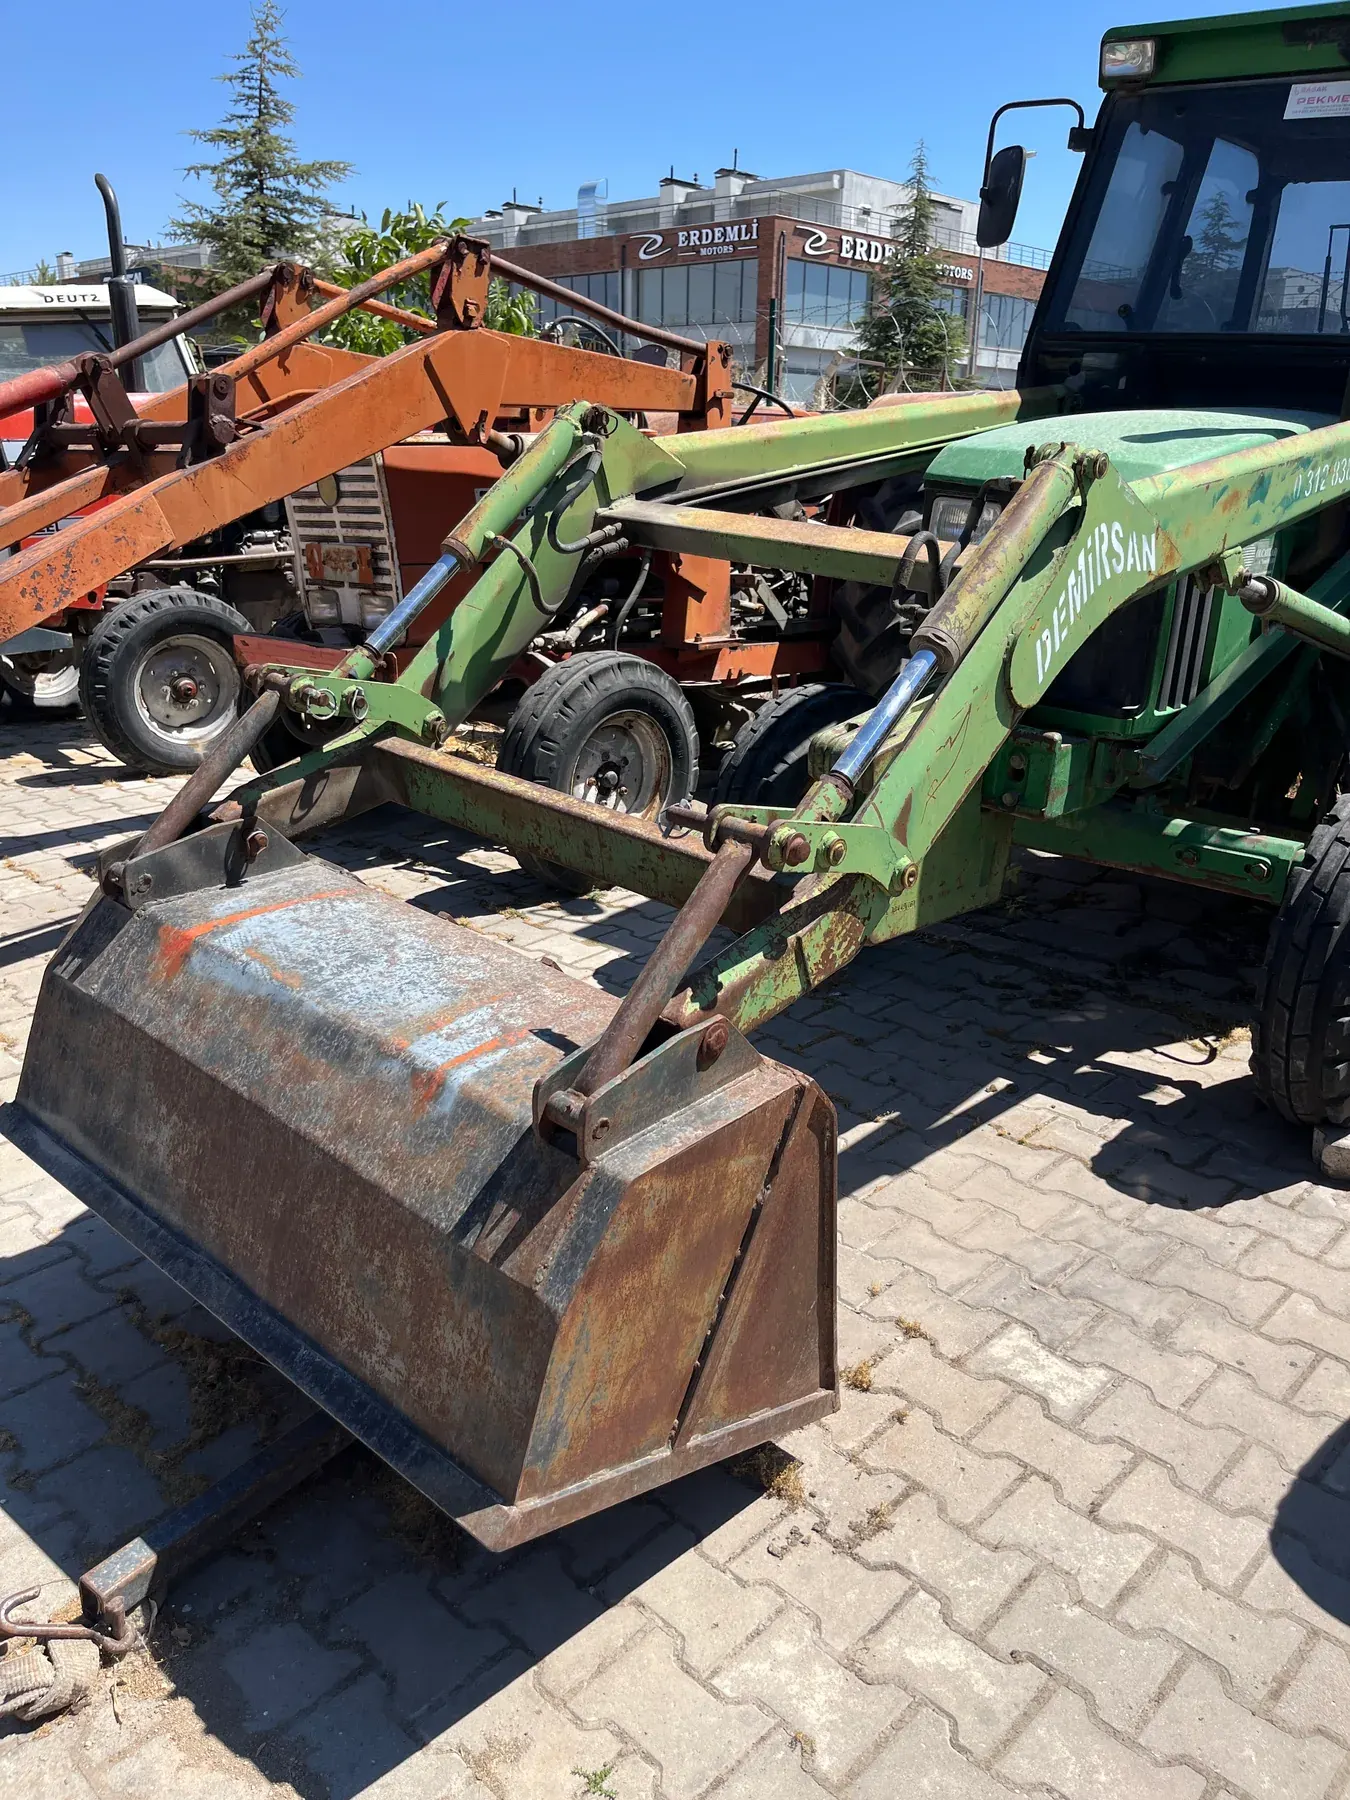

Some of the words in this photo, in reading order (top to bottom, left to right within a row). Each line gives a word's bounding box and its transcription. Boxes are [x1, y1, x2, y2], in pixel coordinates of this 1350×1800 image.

[678, 218, 758, 247] ERDEMLİ
[700, 245, 734, 256] MOTORS
[44, 293, 100, 303] DEUTZ
